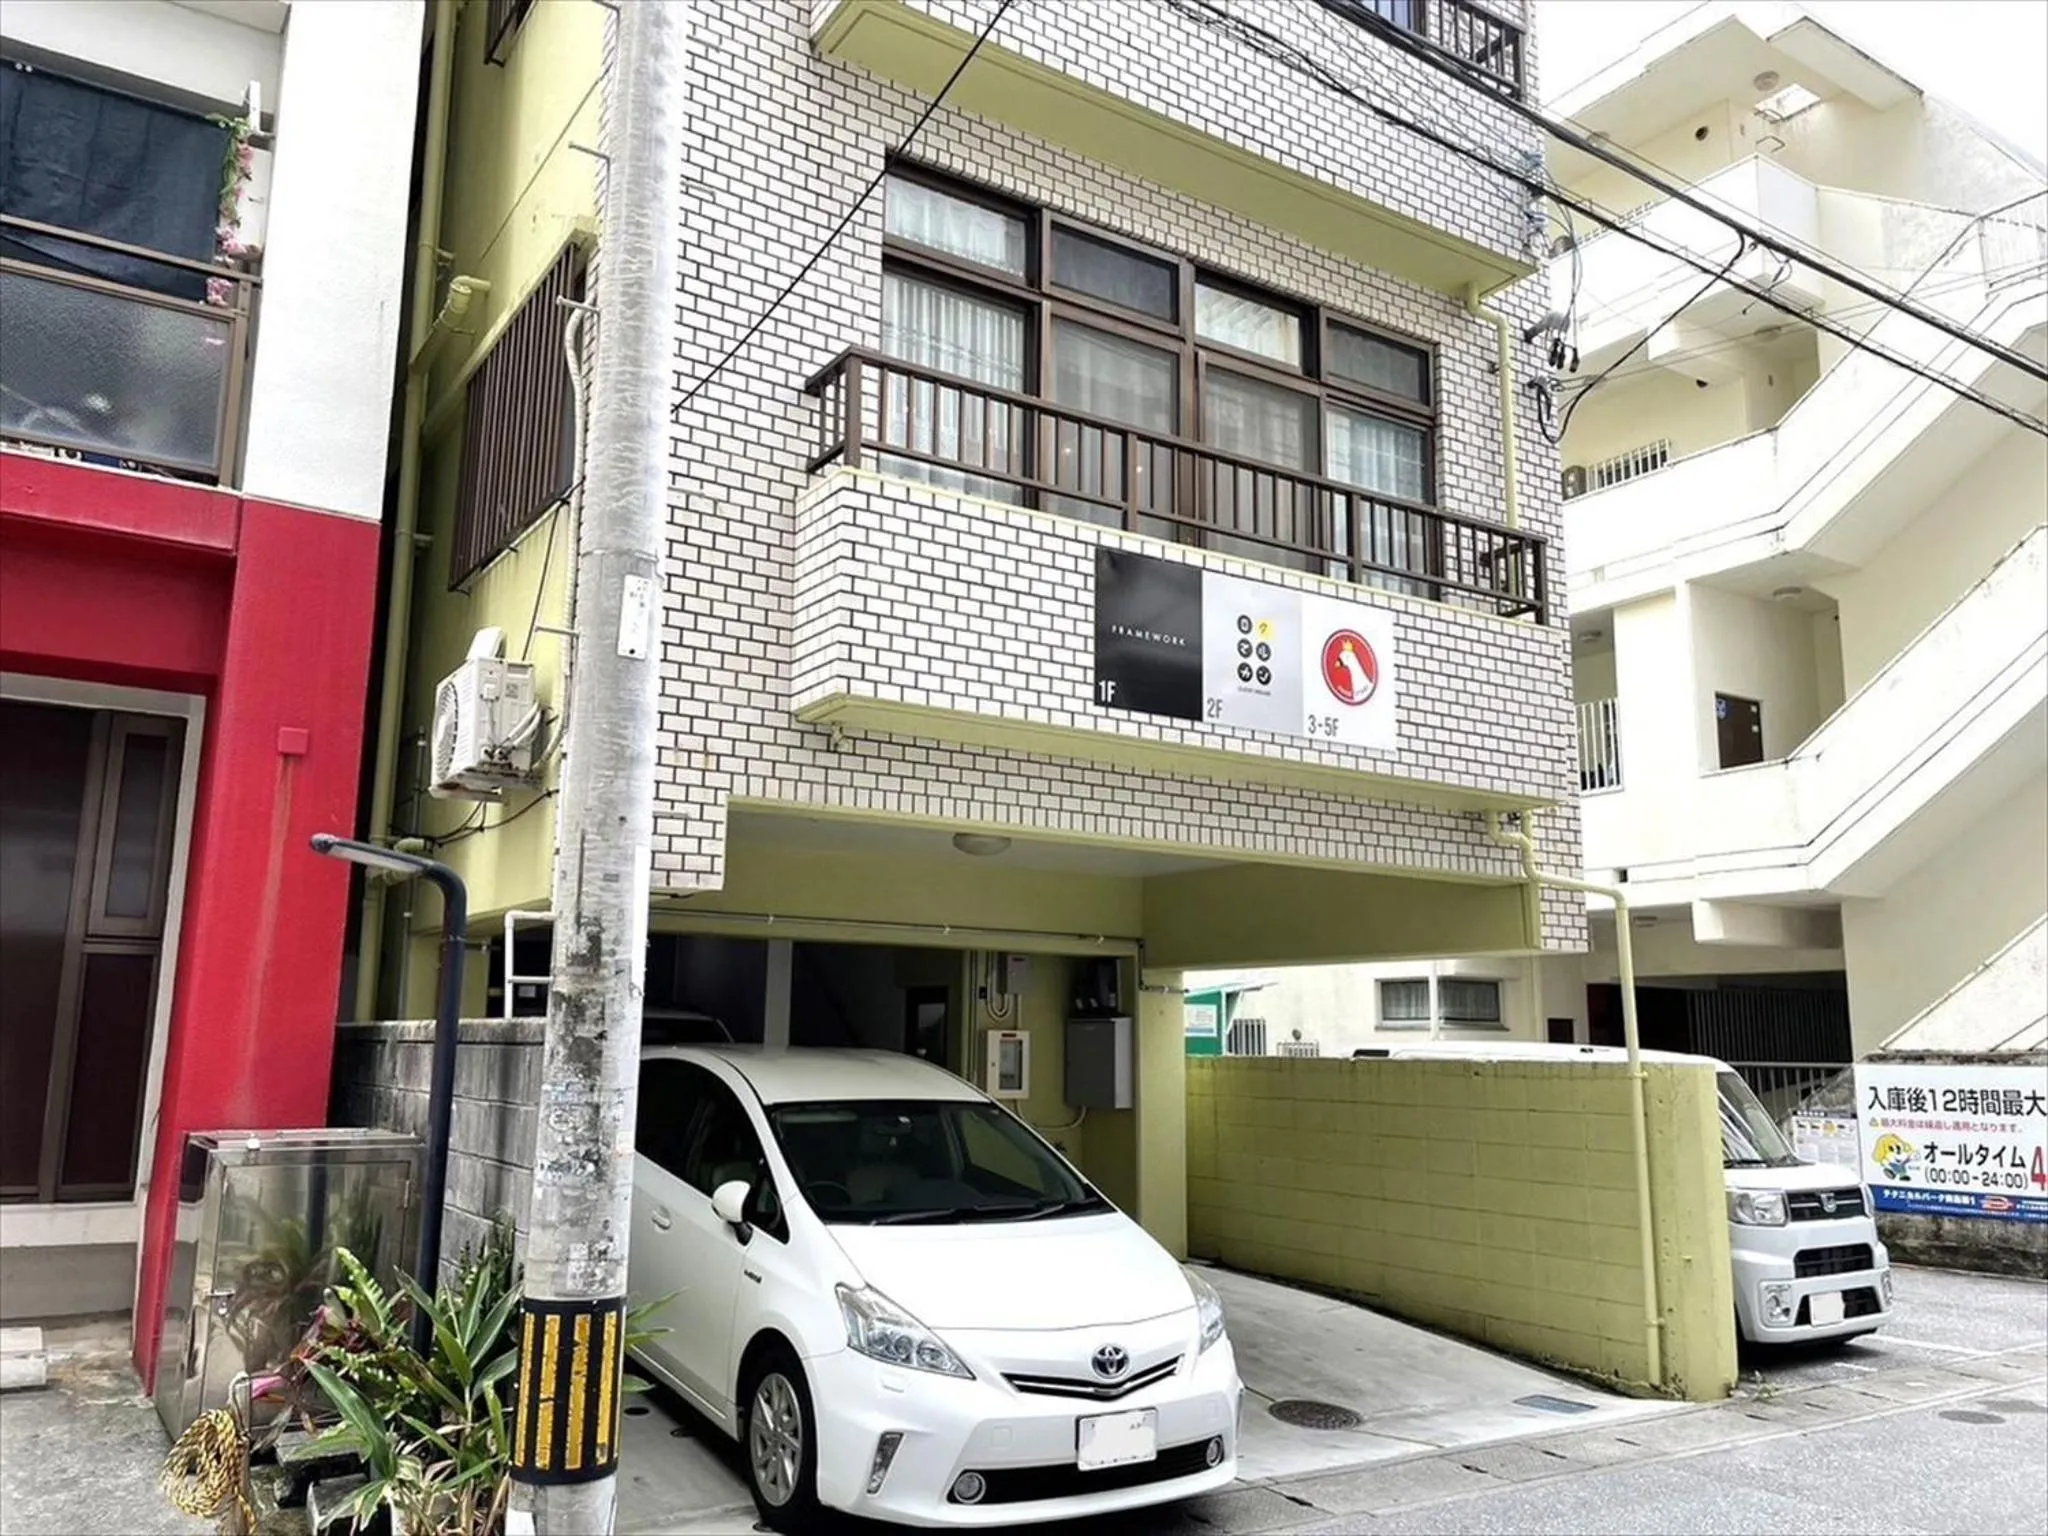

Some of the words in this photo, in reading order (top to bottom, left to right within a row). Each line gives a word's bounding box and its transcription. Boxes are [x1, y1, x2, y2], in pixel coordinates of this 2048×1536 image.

[1111, 624, 1187, 646] FRAMEWORK
[1099, 680, 1117, 704] 1F
[1206, 697, 1224, 719] 2F
[1867, 1086, 2047, 1118] 入庫後12時間最大
[1923, 1141, 2027, 1169] オールタイム
